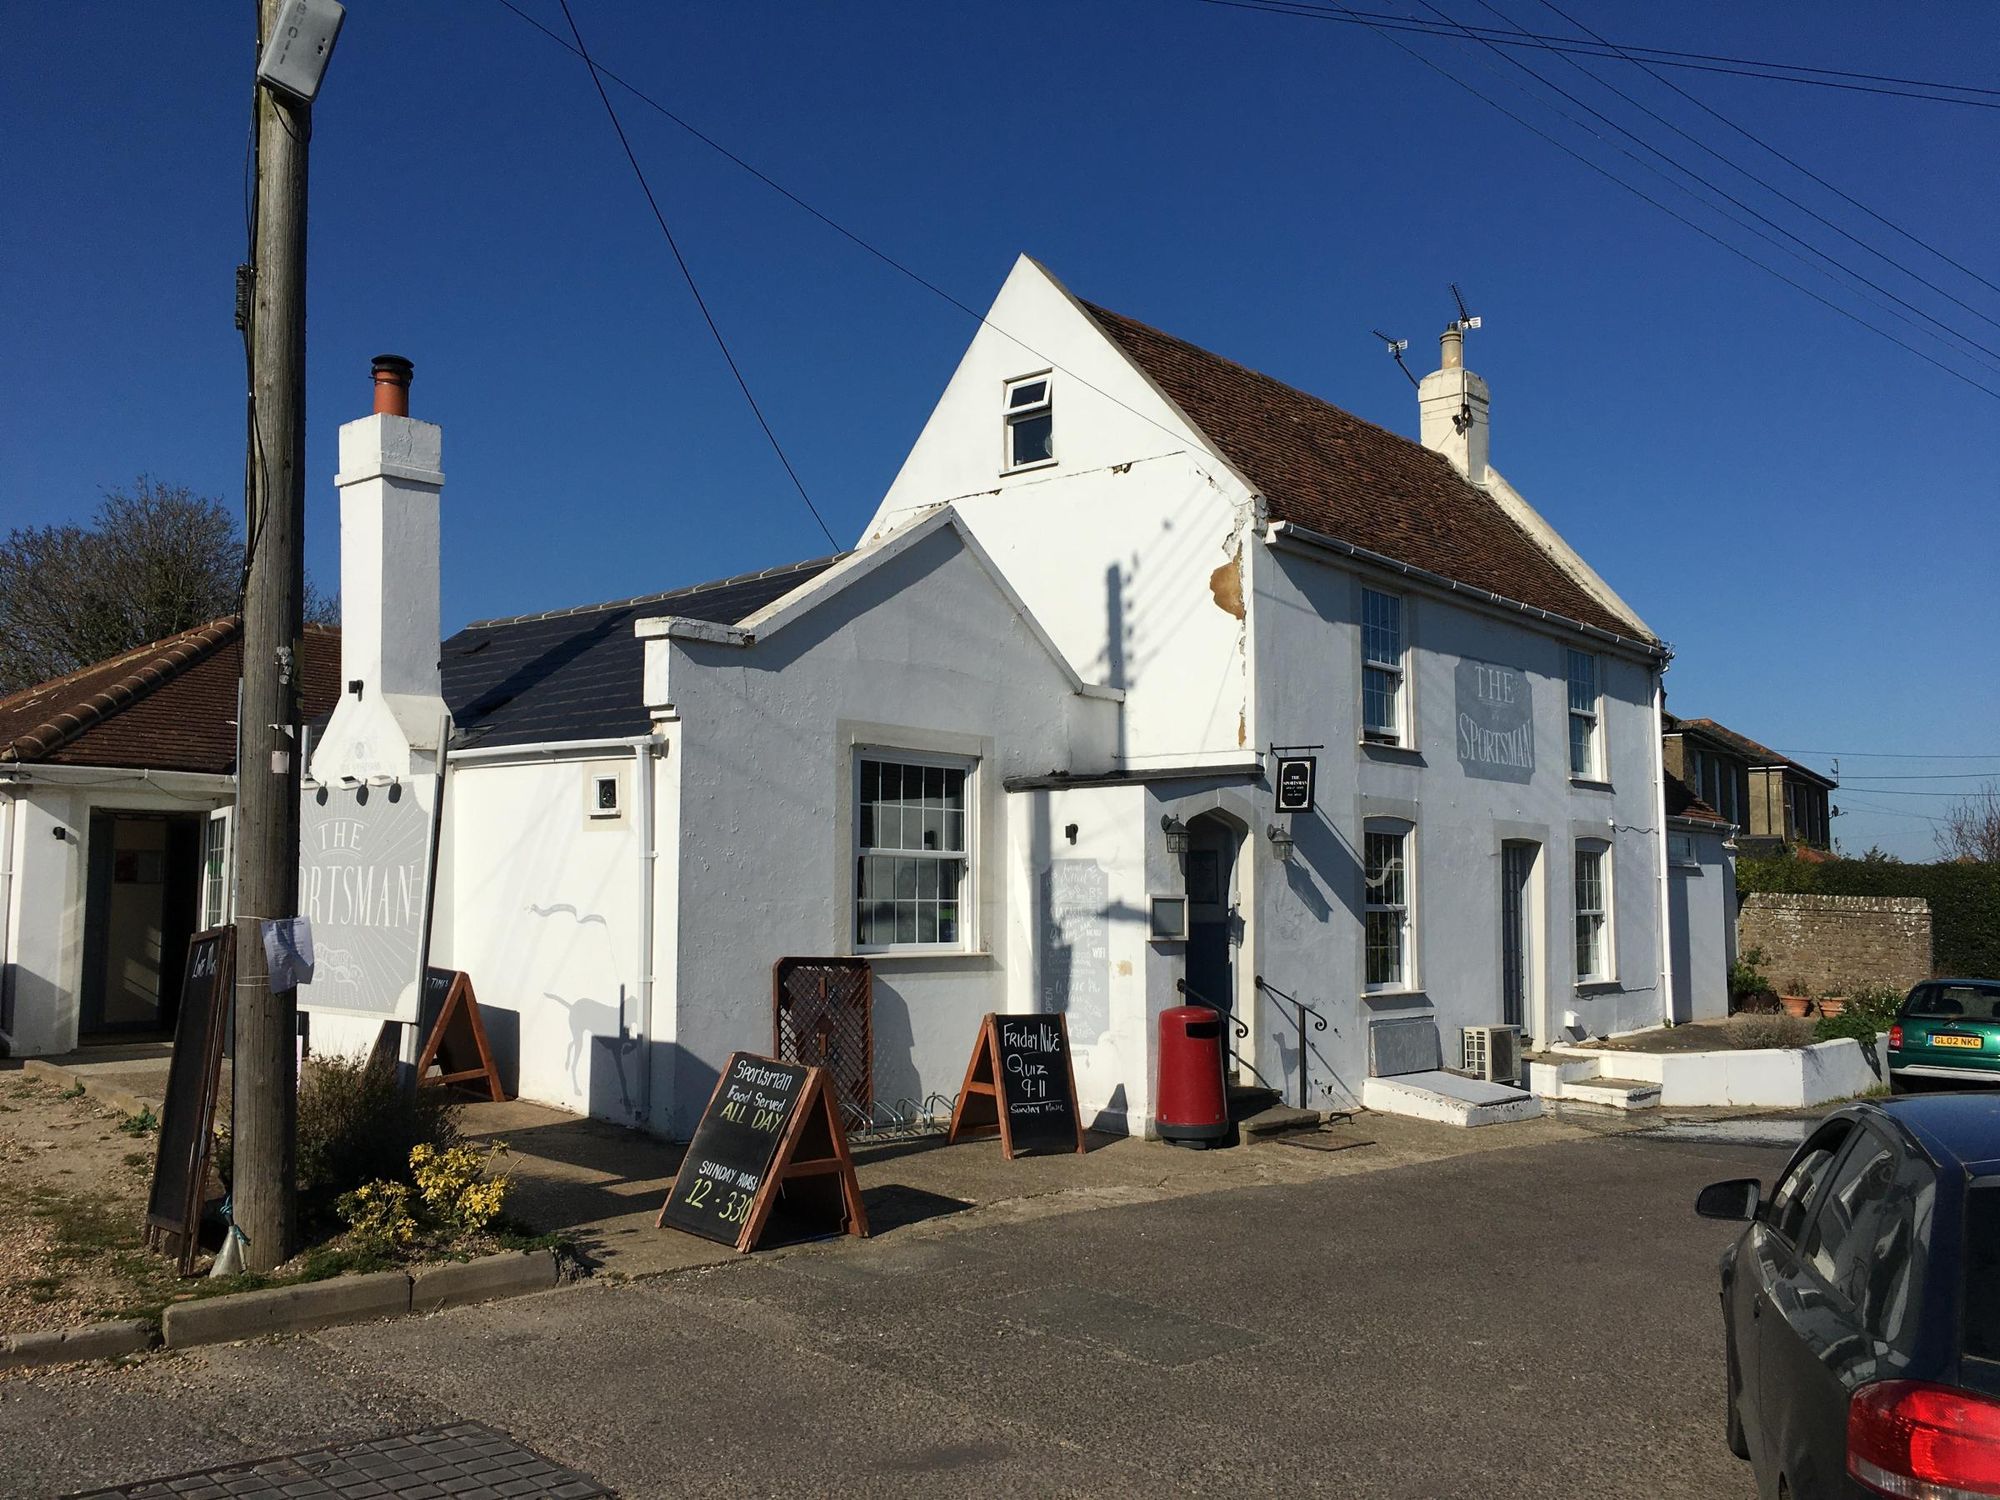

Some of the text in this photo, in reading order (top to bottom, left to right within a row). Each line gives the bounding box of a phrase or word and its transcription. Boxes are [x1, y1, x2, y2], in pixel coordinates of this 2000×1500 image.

[1475, 666, 1515, 703] THE
[1459, 712, 1532, 768] SPORTSMAN
[318, 822, 364, 851] THE
[298, 865, 415, 928] ORTSMAN
[733, 1060, 793, 1092] Sportsman
[727, 1084, 786, 1113] Food Served
[720, 1102, 784, 1134] ALL DAY
[699, 1160, 737, 1184] SUNDAY
[685, 1178, 712, 1209] 12
